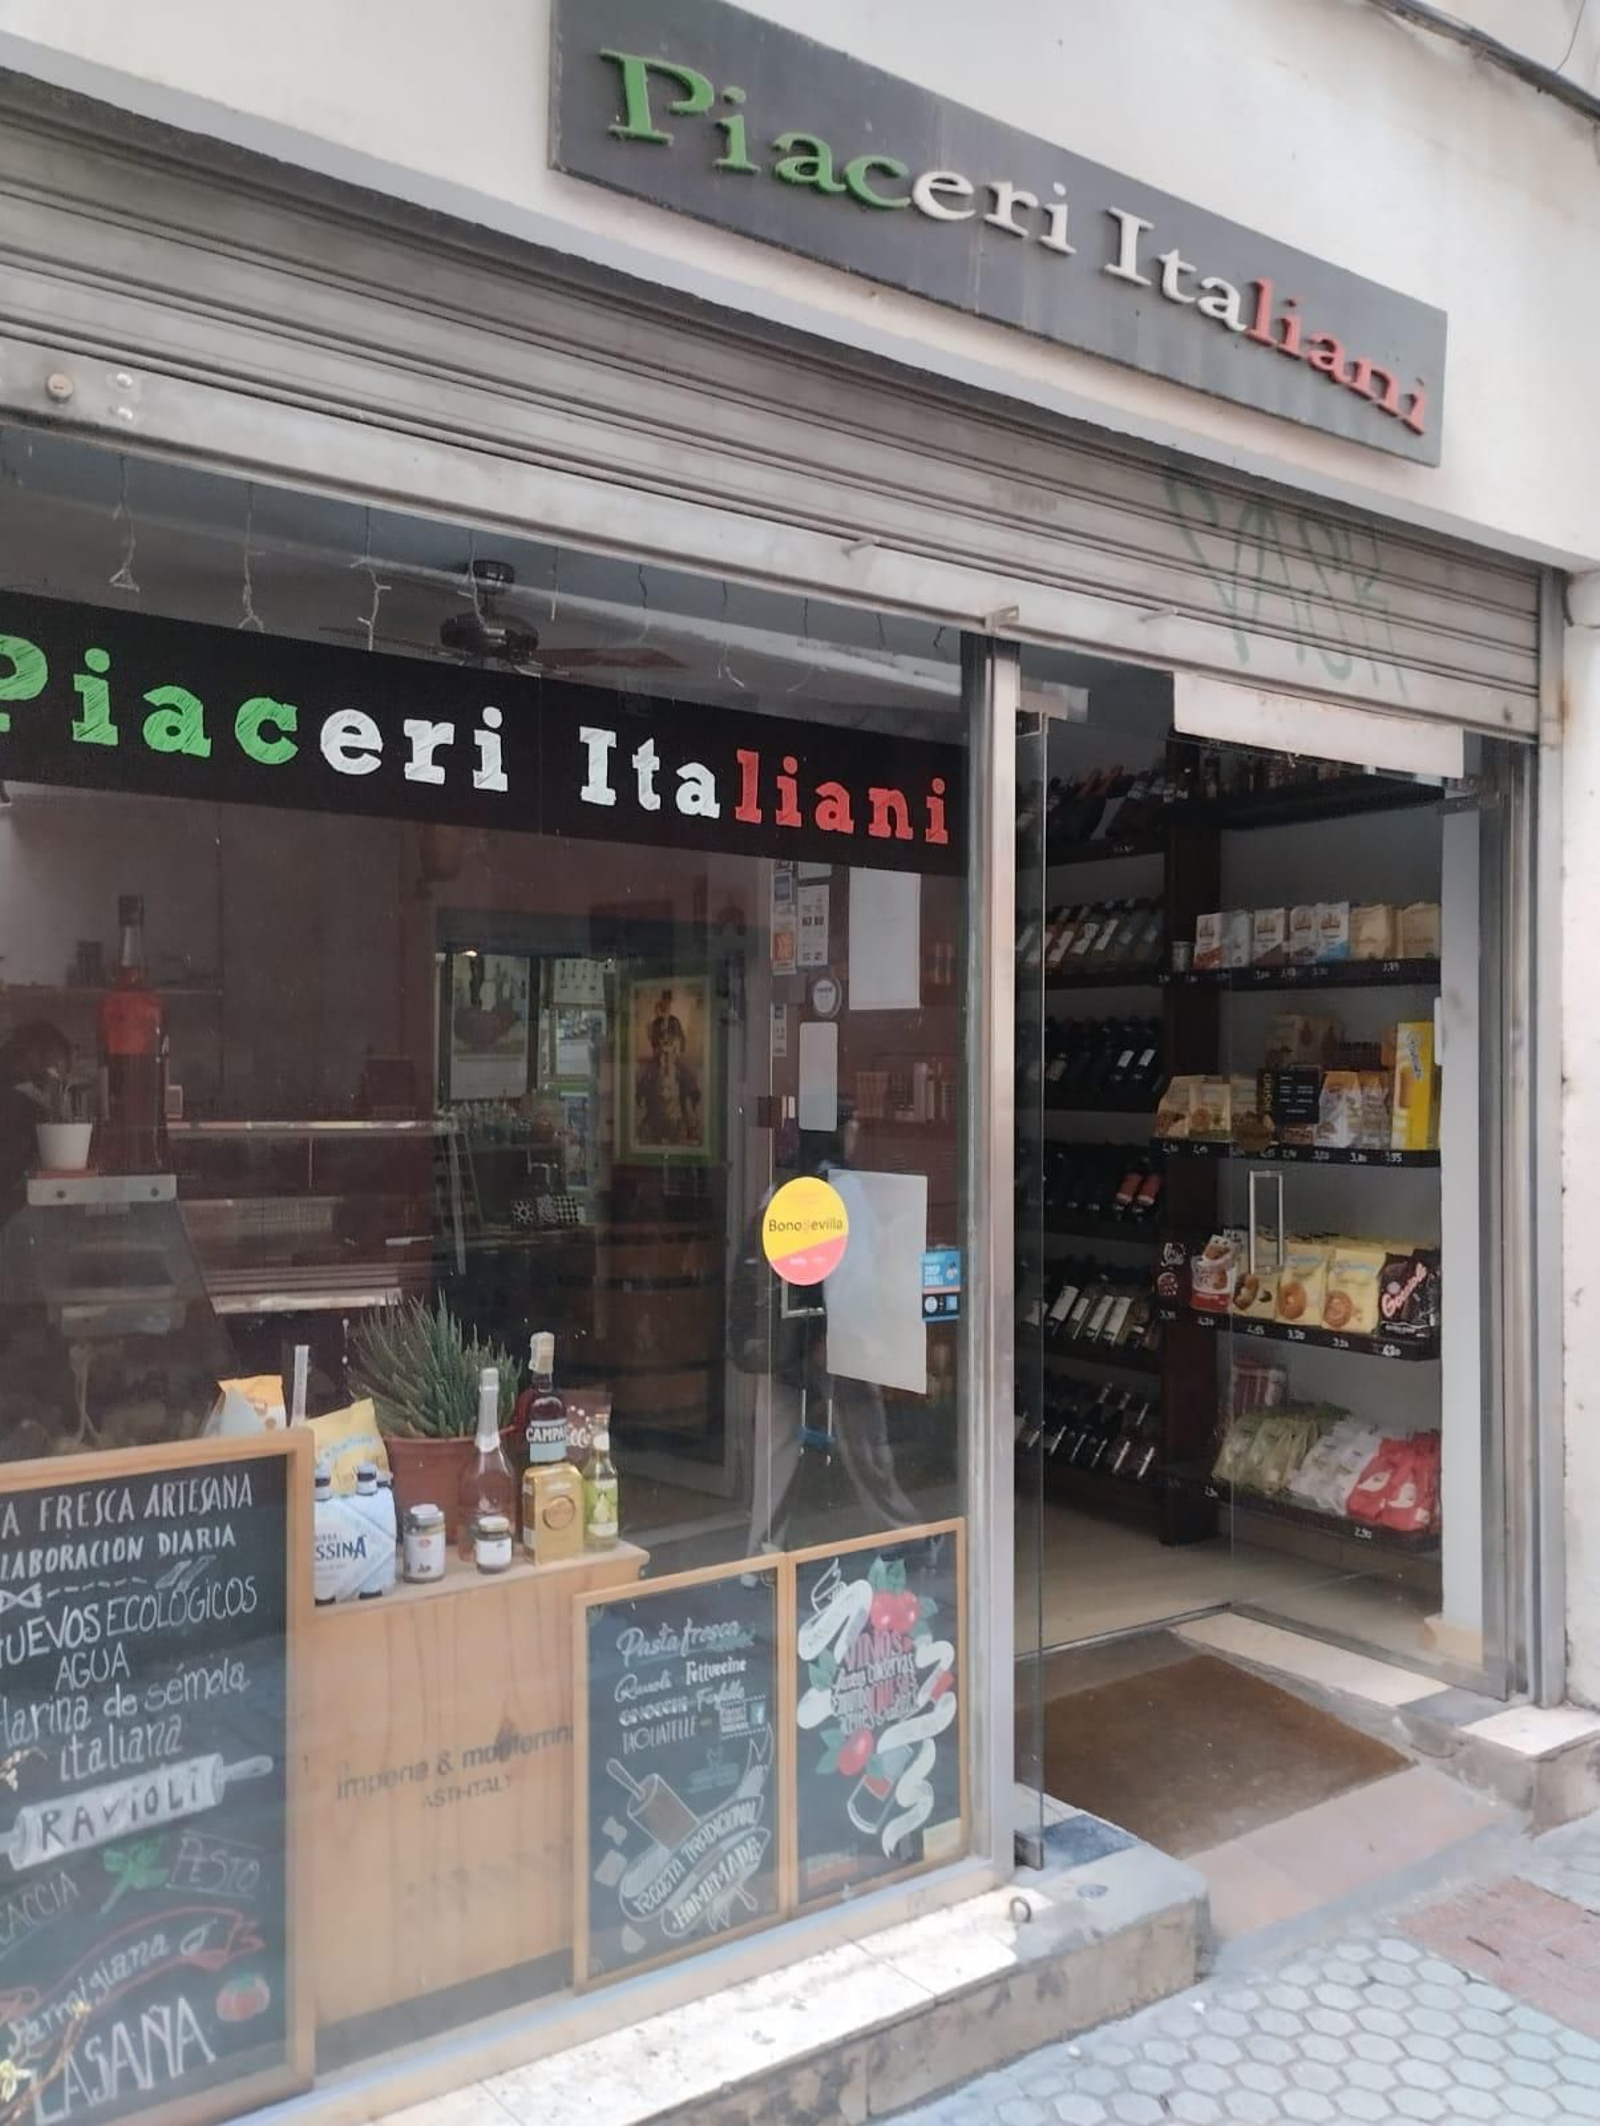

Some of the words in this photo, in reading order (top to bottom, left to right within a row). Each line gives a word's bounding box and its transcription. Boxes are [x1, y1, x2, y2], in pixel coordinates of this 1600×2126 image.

[601, 49, 1077, 257] Piaceri
[1103, 206, 1426, 436] Italiani
[0, 634, 509, 793] Piaceri
[579, 725, 951, 845] Italiani
[40, 1487, 135, 1532] FRESCA
[144, 1472, 253, 1519] ARTESANA
[158, 1523, 236, 1558] DIARIA
[55, 1642, 130, 1691] AGUA
[103, 1684, 138, 1719] de
[145, 1657, 251, 1713] sémola
[60, 1714, 183, 1782] italiana
[436, 1751, 453, 1776] &
[171, 1837, 261, 1894] PESTO
